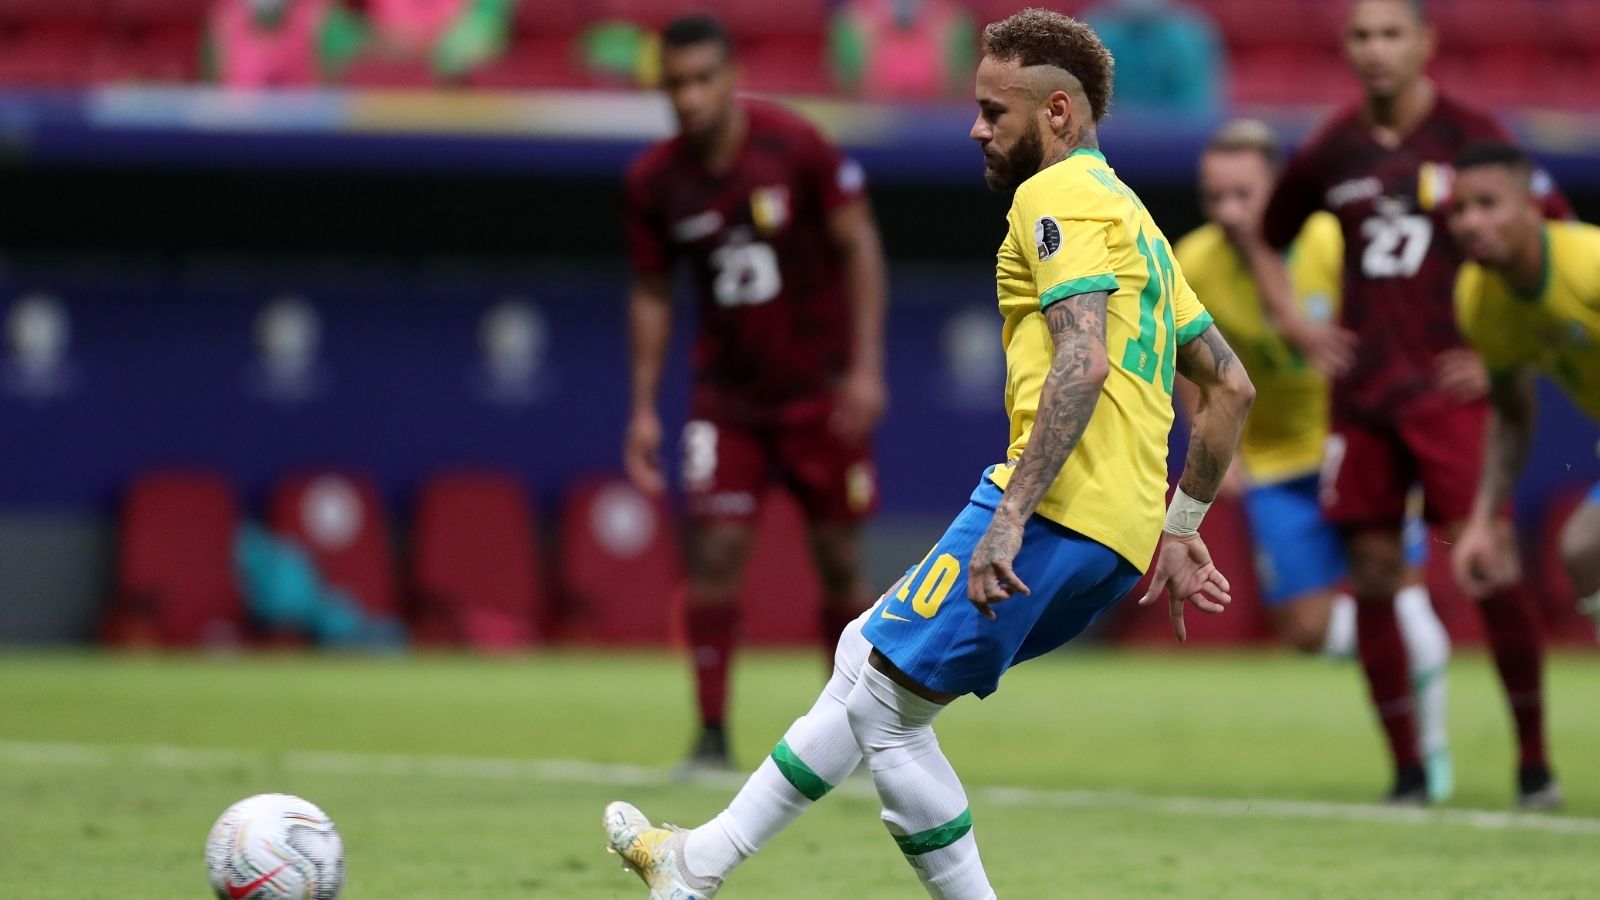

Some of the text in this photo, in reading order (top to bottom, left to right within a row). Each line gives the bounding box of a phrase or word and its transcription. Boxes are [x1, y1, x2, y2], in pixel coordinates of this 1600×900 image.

[711, 243, 781, 306] 23
[1361, 215, 1432, 277] 27
[896, 543, 960, 619] 10
